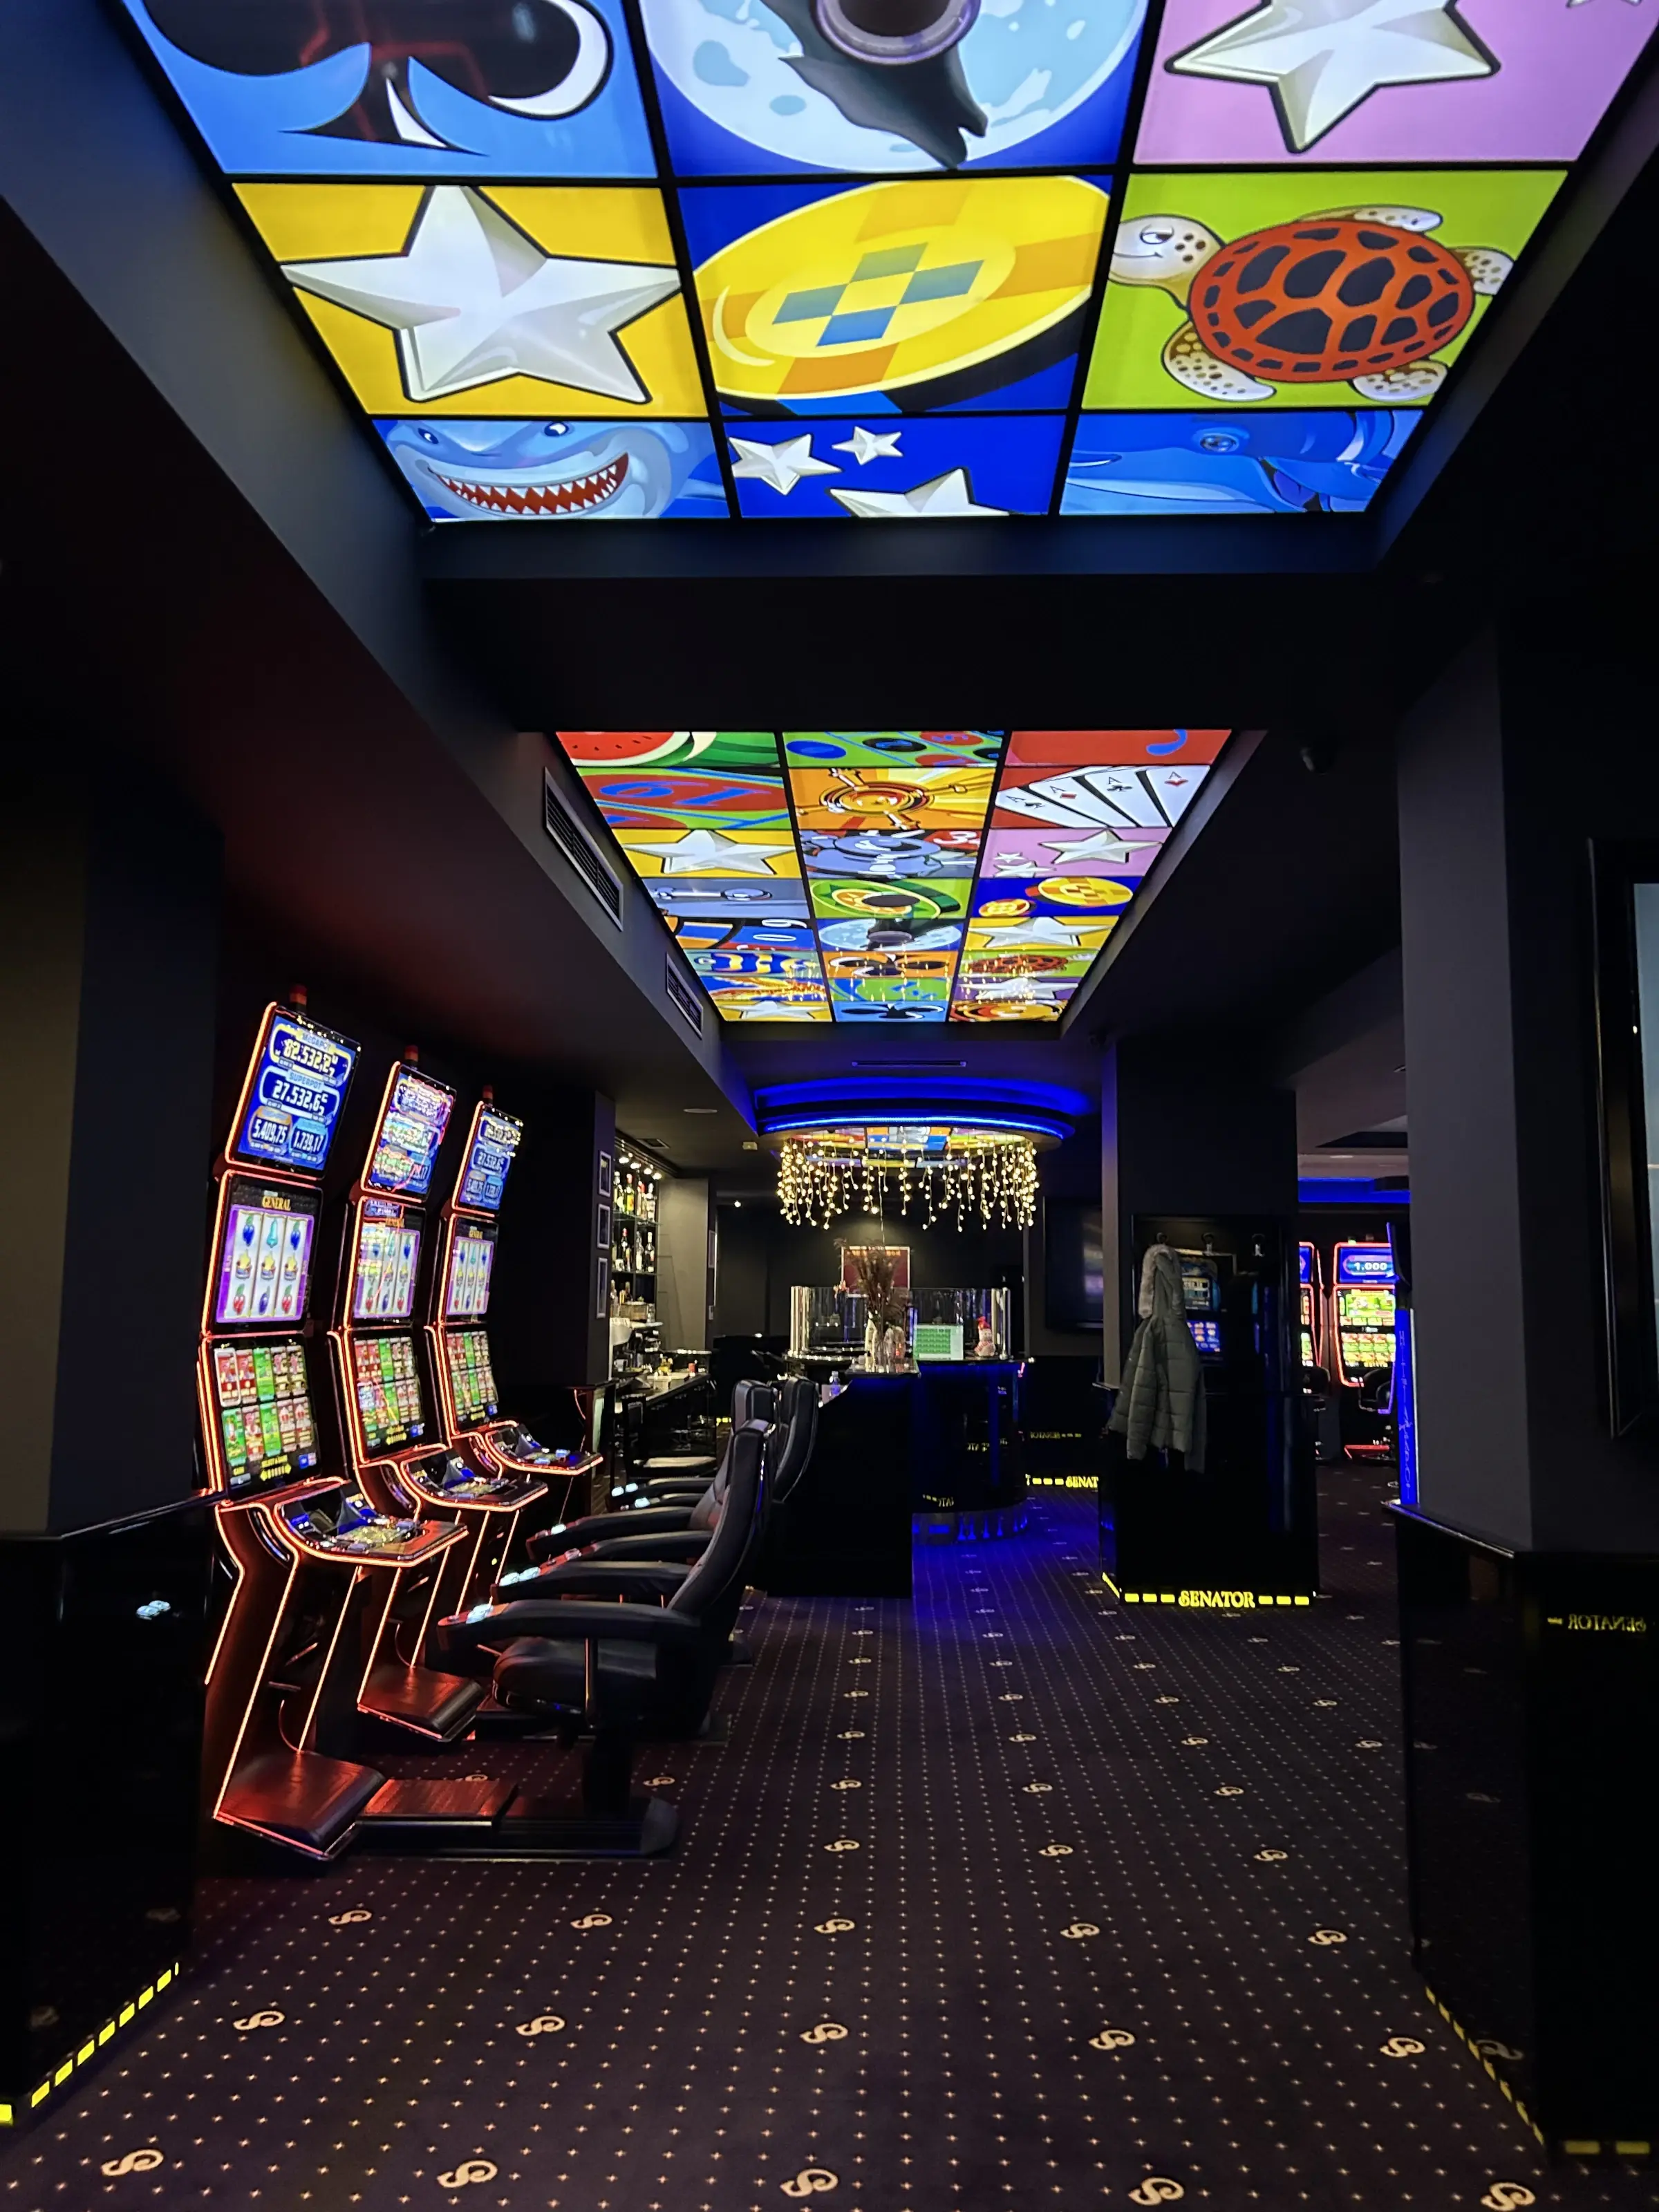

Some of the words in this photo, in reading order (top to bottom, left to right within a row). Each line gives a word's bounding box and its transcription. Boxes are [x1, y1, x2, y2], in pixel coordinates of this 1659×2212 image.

[289, 1071, 322, 1090] SUPERPOT
[262, 1195, 291, 1211] GENERAL
[1353, 1262, 1388, 1271] 1.000
[1178, 1591, 1256, 1609] SENATOR
